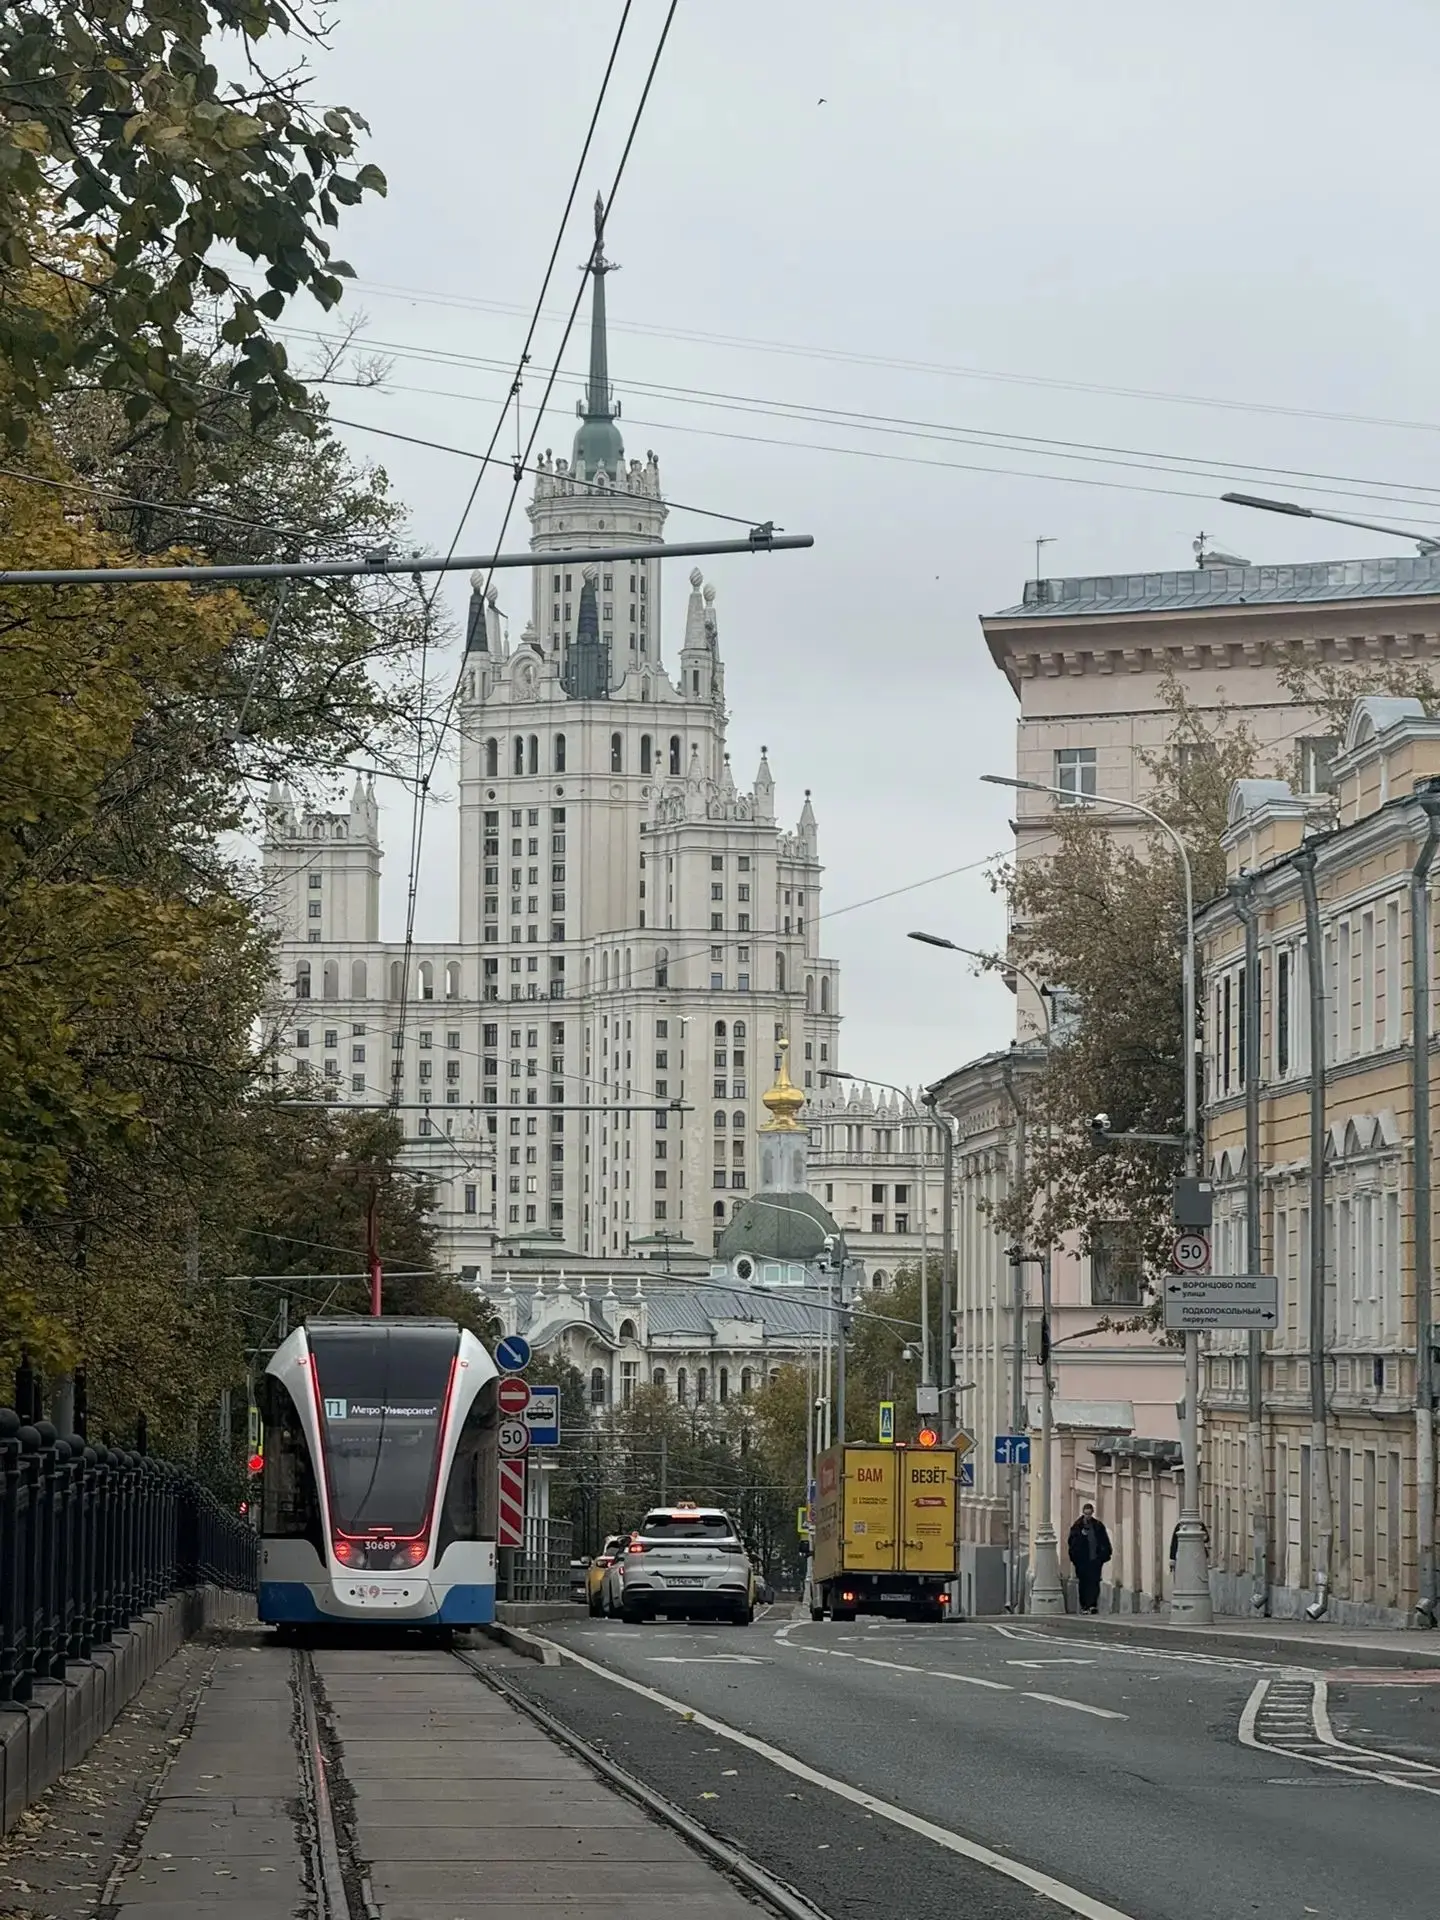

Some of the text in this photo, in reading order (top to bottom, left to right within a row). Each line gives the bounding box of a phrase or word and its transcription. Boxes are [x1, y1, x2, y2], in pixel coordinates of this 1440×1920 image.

[1180, 1244, 1202, 1259] 50
[1182, 1281, 1233, 1290] ВОРОНЦОВО
[1182, 1306, 1261, 1315] ПОДКОЛОКОЛЬНЫЙ
[351, 1405, 380, 1415] Метро
[501, 1429, 523, 1445] 50
[857, 1466, 947, 1484] ВАМ ВЕЗЁТ
[364, 1540, 397, 1550] 30689
